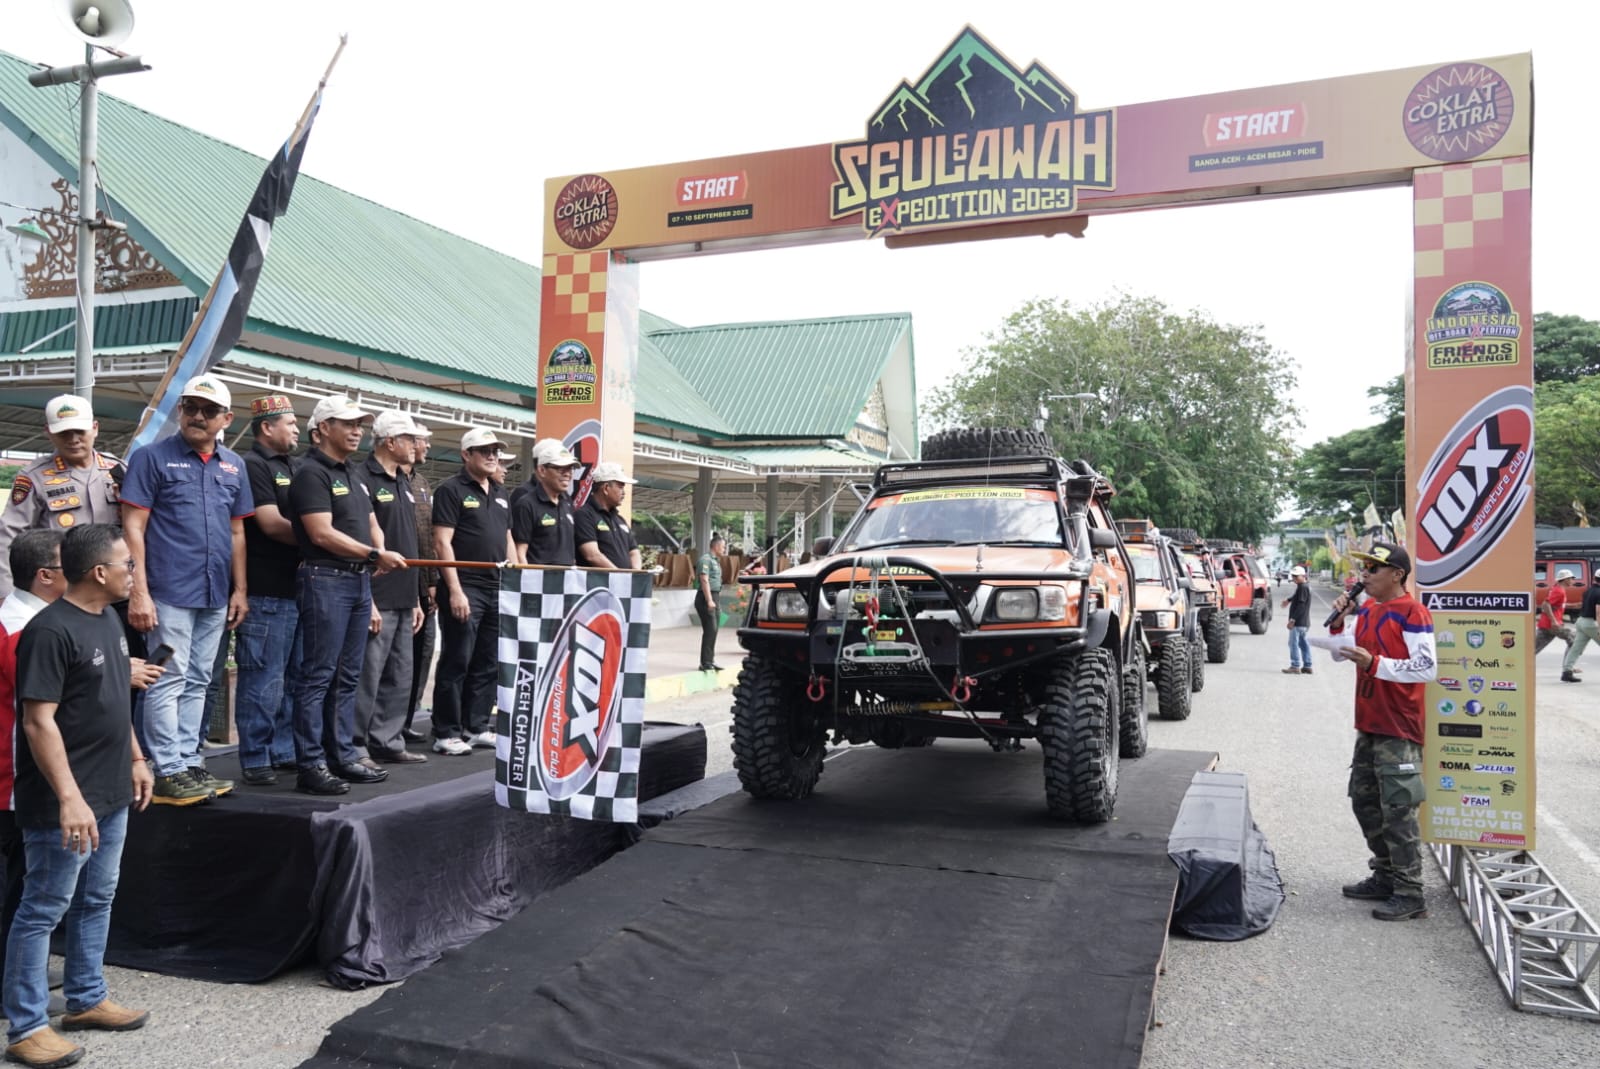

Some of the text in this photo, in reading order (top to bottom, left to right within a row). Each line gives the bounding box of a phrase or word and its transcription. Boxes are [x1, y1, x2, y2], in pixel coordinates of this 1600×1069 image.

[1408, 81, 1498, 122] COKLAT
[1216, 109, 1295, 141] START
[1437, 102, 1495, 134] EXTRA
[1194, 158, 1220, 168] BANDA
[1221, 156, 1241, 165] ACEH
[1246, 153, 1266, 162] ACEH
[1267, 149, 1291, 160] BESAR
[1297, 147, 1317, 157] PIDIE
[682, 175, 739, 201] START
[557, 189, 610, 219] COKLAT
[1012, 187, 1070, 212] 2023
[574, 205, 608, 228] EXTRA
[693, 210, 732, 221] SEPTEMBER
[732, 209, 750, 217] 2023
[1429, 314, 1517, 330] INDONESIA
[1433, 342, 1513, 358] FRIENDS
[1433, 354, 1513, 365] CHALLENGE
[547, 386, 592, 397] FRIENDS
[1472, 450, 1526, 532] adventure club
[1427, 594, 1525, 610] ACEH CHAPTER
[512, 666, 535, 782] ACEH CHAPTER
[549, 676, 563, 778] adventure club
[1471, 797, 1490, 806] FAM
[1432, 807, 1523, 820] WE LIVE TO
[1432, 816, 1523, 831] DISCOVER
